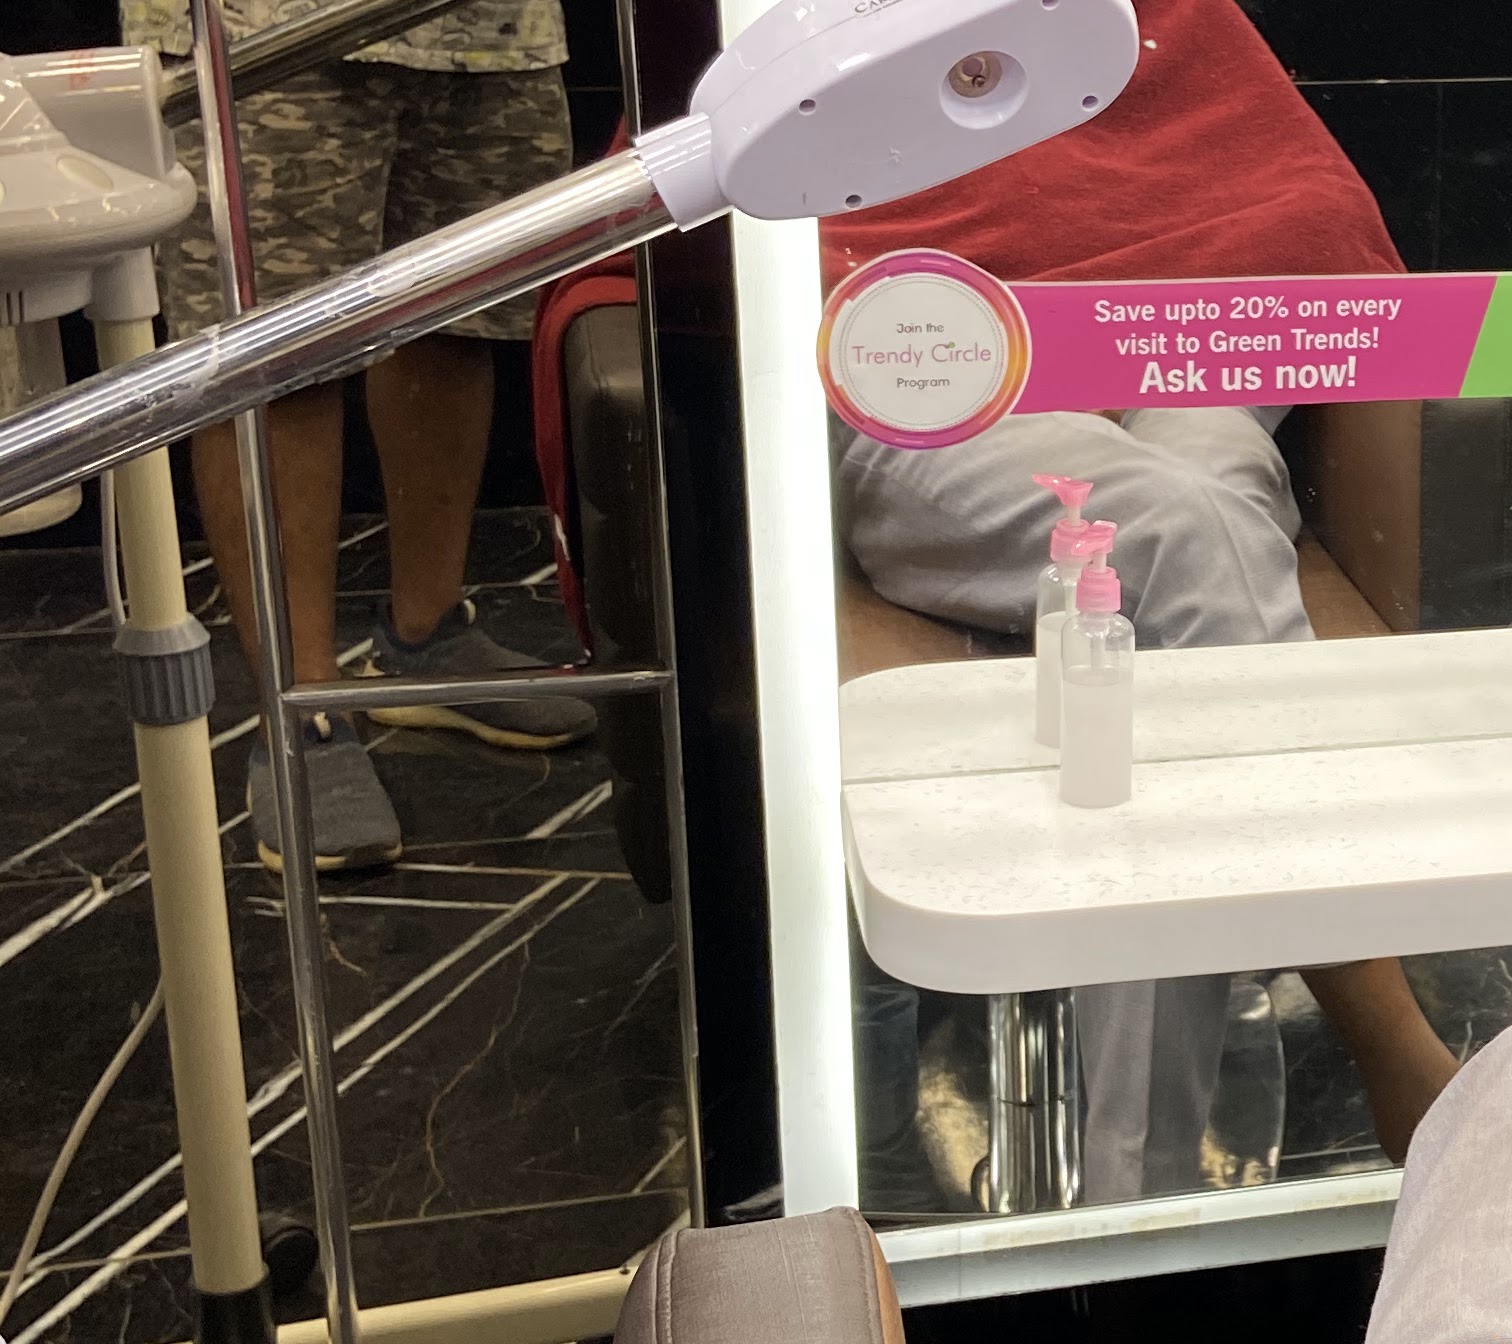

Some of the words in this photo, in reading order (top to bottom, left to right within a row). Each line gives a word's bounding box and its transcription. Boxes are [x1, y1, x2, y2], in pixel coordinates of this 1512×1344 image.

[1094, 299, 1156, 323] Save
[1164, 298, 1221, 326] upto
[1229, 295, 1290, 319] 20%
[1297, 299, 1328, 318] on
[1336, 298, 1402, 321] every
[896, 322, 923, 334] Join
[926, 322, 945, 333] the
[1114, 332, 1169, 356] visit
[1175, 332, 1201, 355] to
[1208, 330, 1282, 353] Green
[1290, 326, 1380, 351] Trends!
[851, 343, 924, 369] Trendy
[931, 341, 992, 363] Circle
[896, 377, 951, 391] Program
[1138, 359, 1209, 394] Ask
[1220, 365, 1263, 392] us
[1275, 355, 1357, 390] now!
